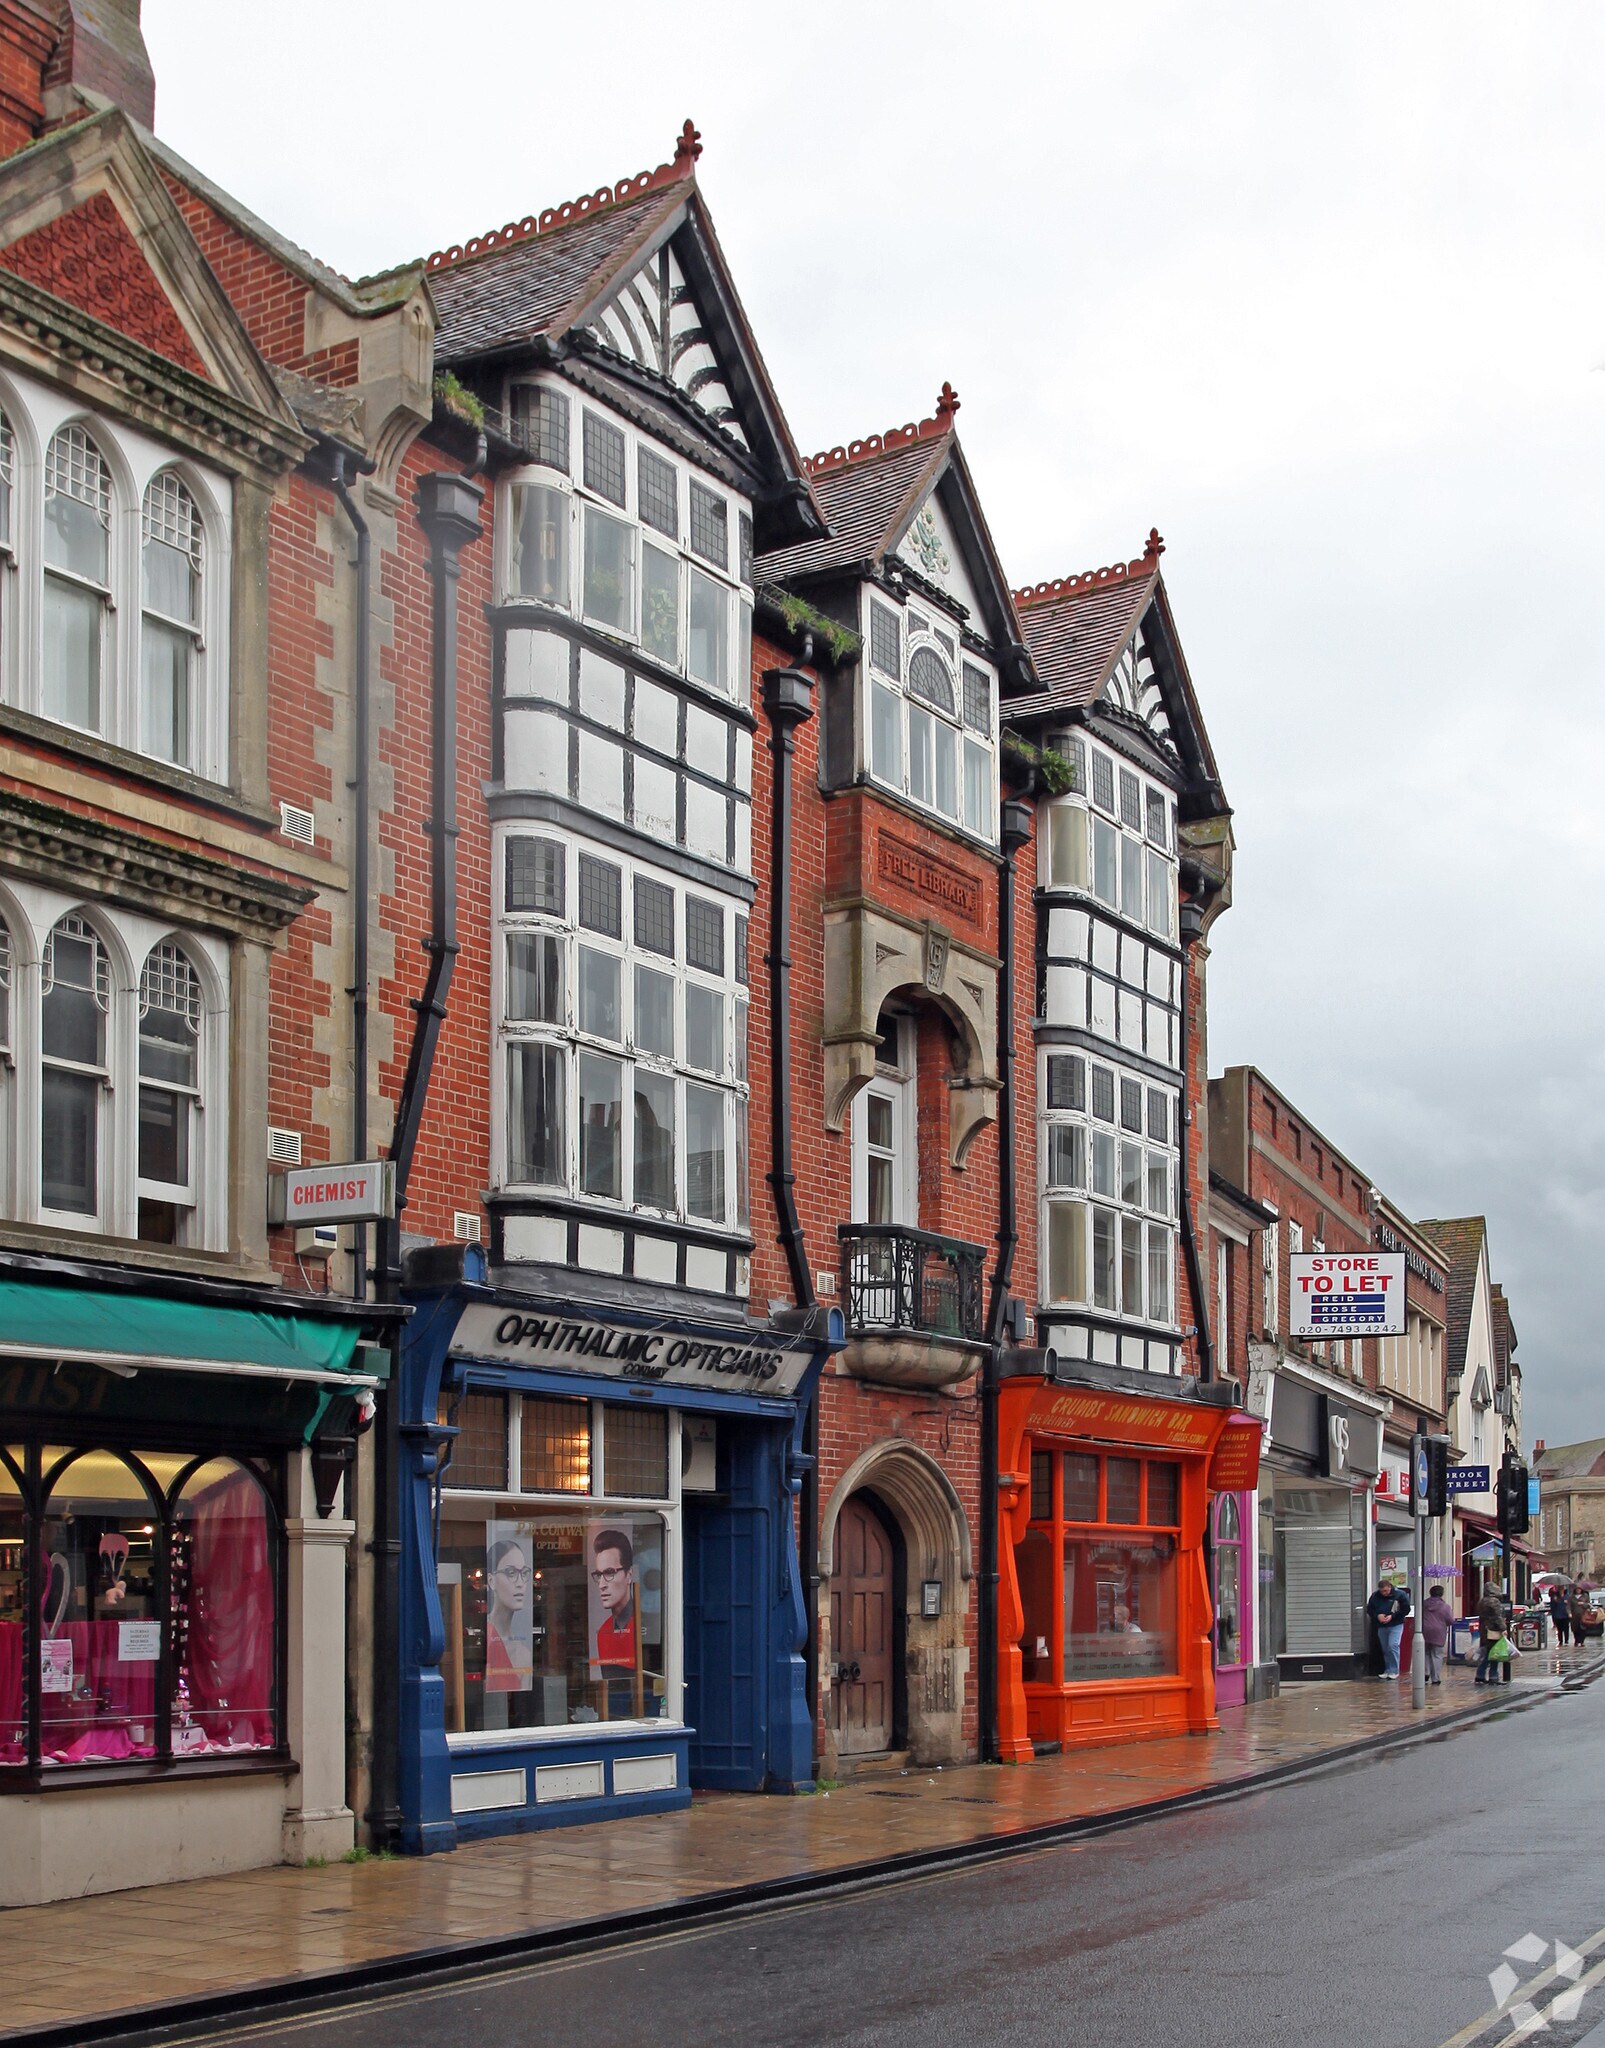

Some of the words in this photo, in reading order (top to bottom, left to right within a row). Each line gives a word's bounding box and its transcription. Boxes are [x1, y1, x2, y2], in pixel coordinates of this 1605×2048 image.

[883, 851, 918, 884] FREE
[918, 866, 972, 910] LIBRARY
[293, 1180, 367, 1205] CHEMIST
[1312, 1258, 1379, 1272] STORE
[1297, 1276, 1333, 1293] TO
[1343, 1275, 1393, 1292] LET
[1365, 1325, 1397, 1333] 4242
[496, 1314, 664, 1364] OPHTHALMIC
[666, 1339, 783, 1380] OPTICIANS
[1051, 1396, 1105, 1419] CRUMBS
[1104, 1404, 1168, 1428] SANDWICH
[1167, 1412, 1193, 1431] BAR
[1446, 1480, 1487, 1489] TREET
[541, 1524, 587, 1537] CONWA
[536, 1541, 573, 1550] OPTICIAN
